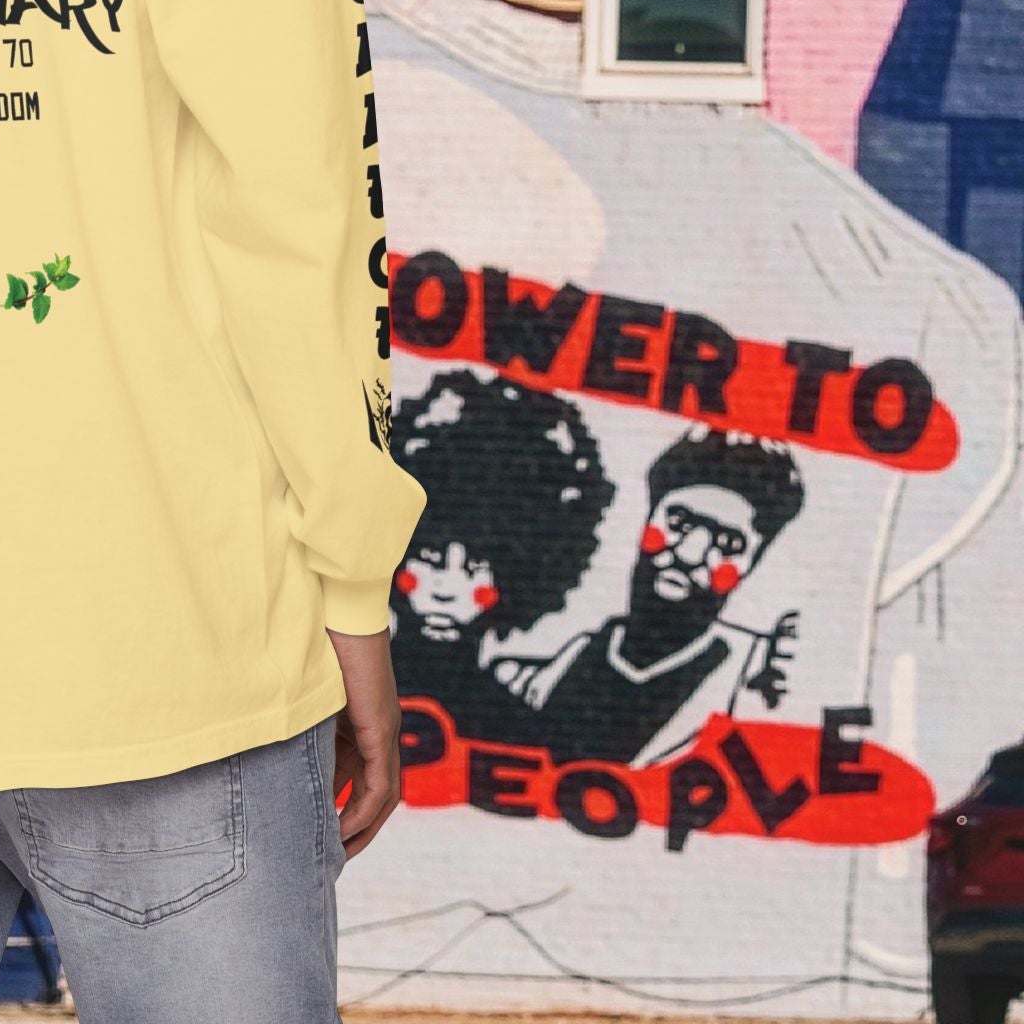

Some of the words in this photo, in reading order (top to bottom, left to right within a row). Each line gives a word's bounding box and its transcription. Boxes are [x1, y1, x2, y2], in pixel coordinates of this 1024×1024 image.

[3, 39, 33, 68] 70
[392, 251, 737, 416] OWER
[786, 340, 933, 454] TO
